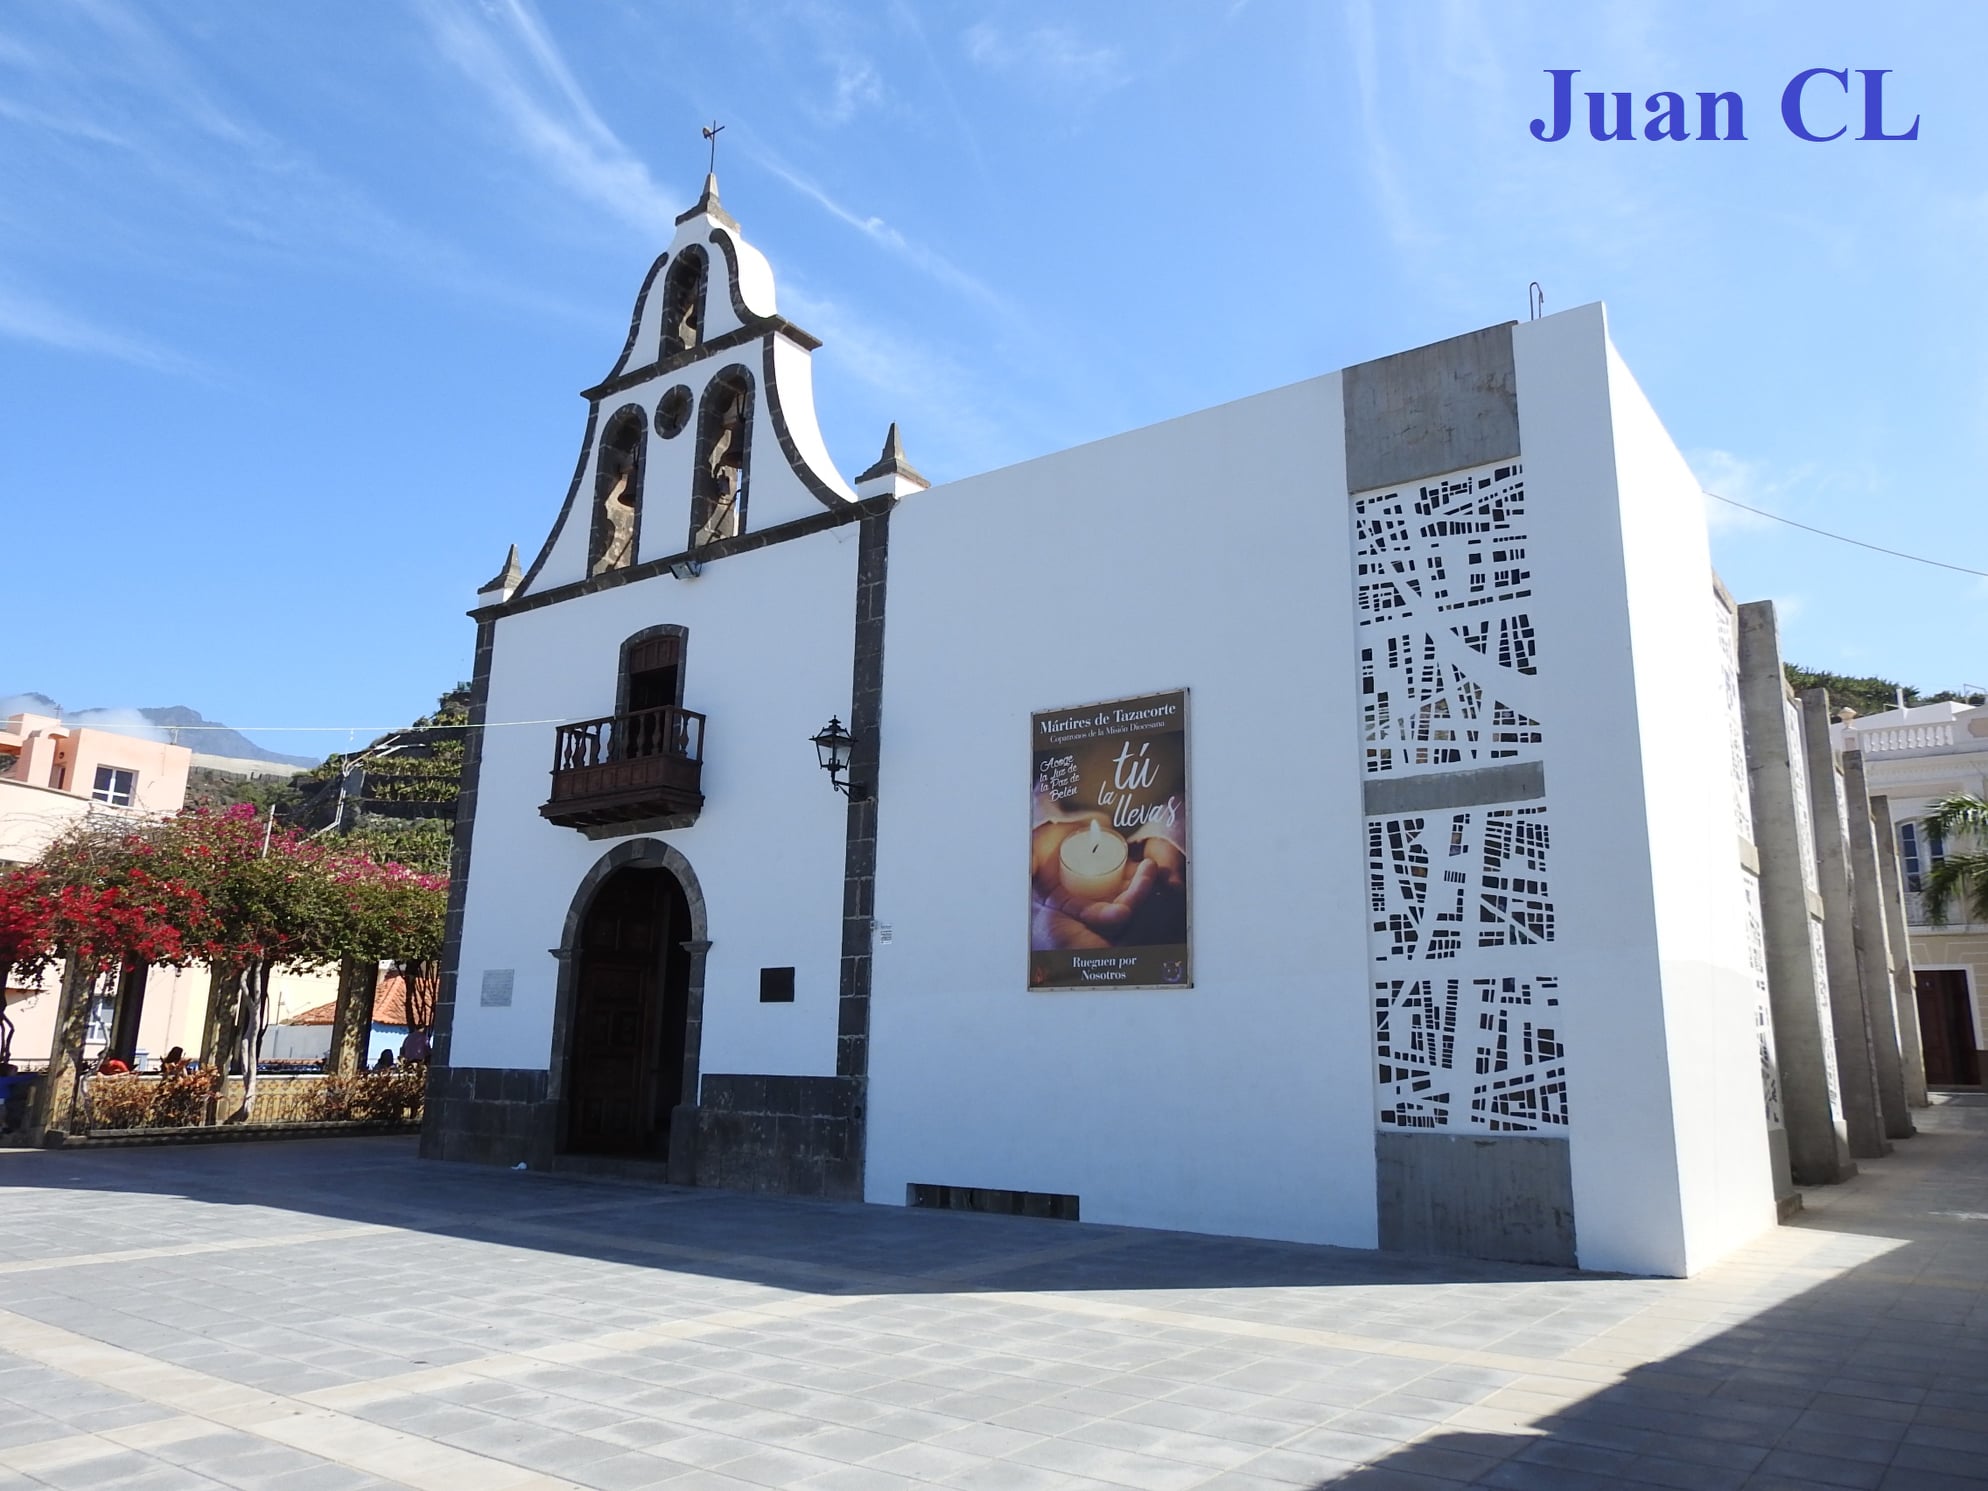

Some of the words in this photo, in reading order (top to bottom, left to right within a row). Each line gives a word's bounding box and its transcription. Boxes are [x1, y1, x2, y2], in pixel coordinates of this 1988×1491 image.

[1040, 717, 1091, 734] Mártires
[1094, 713, 1110, 725] de
[1113, 703, 1176, 723] Tazacorte
[1097, 728, 1104, 736] la
[1106, 725, 1128, 735] Misión
[1129, 721, 1165, 731] Diocesana
[1039, 755, 1074, 772] Acoge
[1039, 773, 1048, 782] la
[1049, 767, 1066, 780] Luz
[1068, 763, 1077, 773] de
[1113, 741, 1160, 789] tú
[1040, 783, 1049, 792] la
[1050, 777, 1069, 789] Paz
[1070, 773, 1080, 782] de
[1049, 786, 1078, 801] Belén
[1098, 780, 1118, 805] la
[1113, 794, 1181, 827] llevas
[1072, 956, 1116, 969] Rueguen
[1118, 957, 1137, 968] por
[1081, 970, 1126, 981] Nosotros
